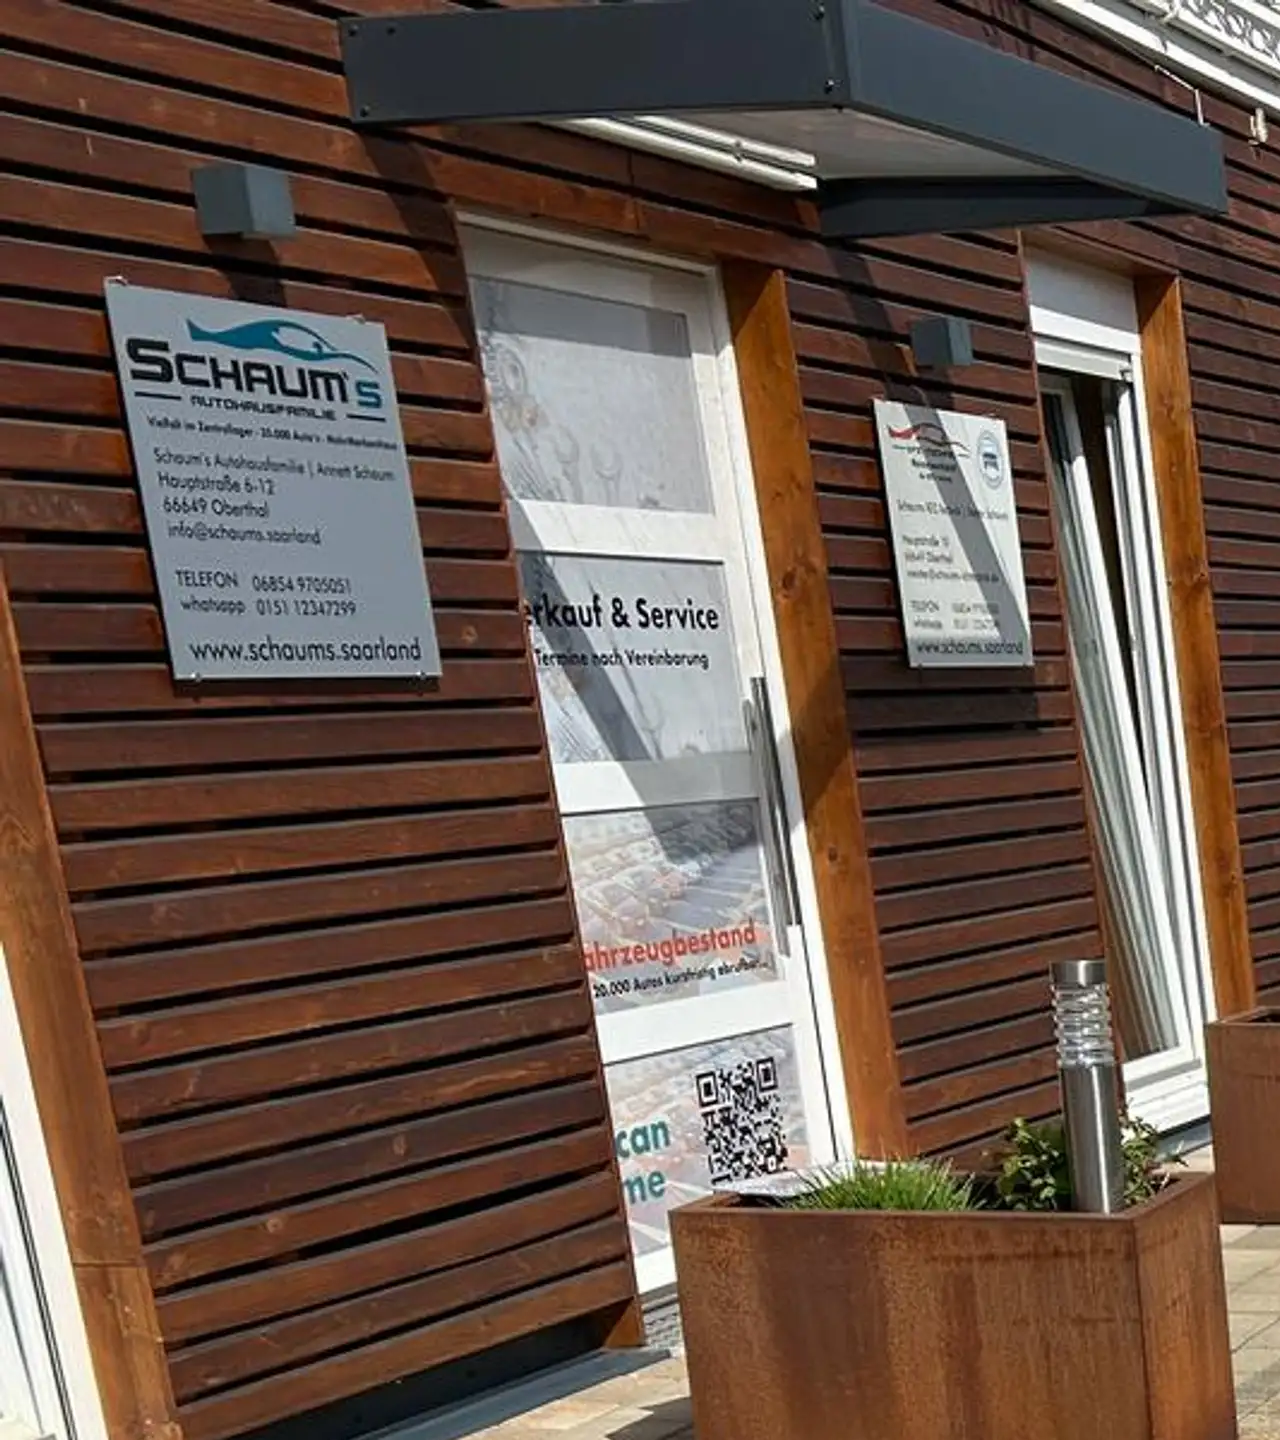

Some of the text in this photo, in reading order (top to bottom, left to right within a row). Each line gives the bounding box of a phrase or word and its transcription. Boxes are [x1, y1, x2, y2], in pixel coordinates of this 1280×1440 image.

[125, 337, 383, 409] SCHAUM'S
[158, 471, 241, 493] Hauptstraße
[163, 496, 270, 518] 66649 Oberthal
[168, 519, 321, 546] info@schaums.saarland
[175, 570, 239, 588] TELEFON
[252, 575, 294, 592] 06854
[180, 595, 246, 615] whatsapp
[256, 598, 290, 616] 0151
[522, 592, 719, 630] erkauf & Service
[190, 634, 422, 662] www.schaums.saarland
[535, 647, 709, 670] Termine nach Vereinbarung
[583, 914, 757, 971] ahrzeugbestand
[633, 974, 664, 993] Autos
[616, 1120, 671, 1159] can
